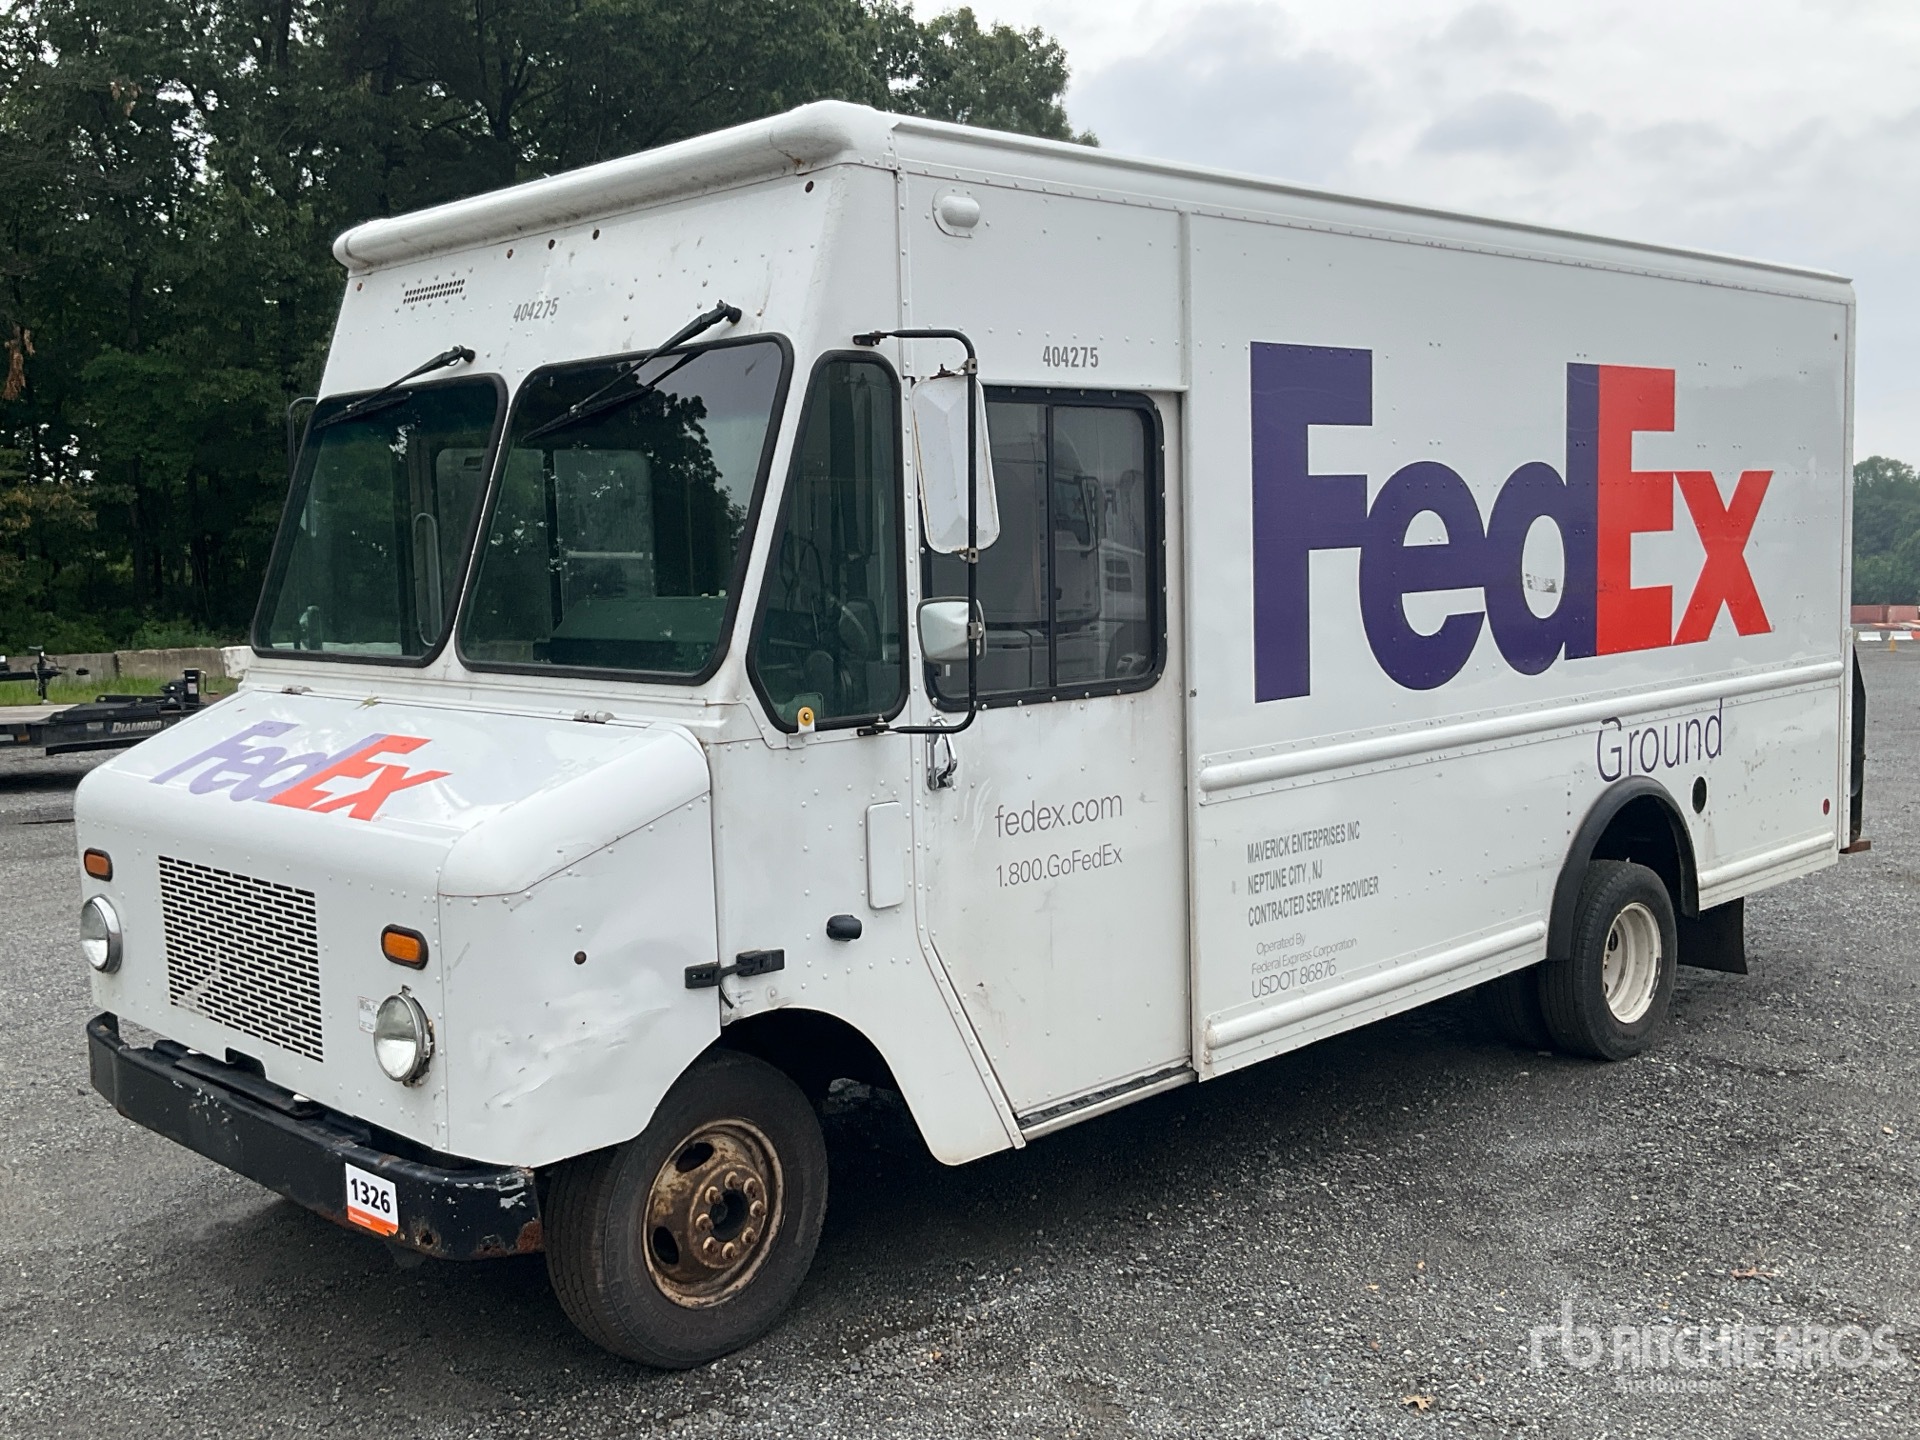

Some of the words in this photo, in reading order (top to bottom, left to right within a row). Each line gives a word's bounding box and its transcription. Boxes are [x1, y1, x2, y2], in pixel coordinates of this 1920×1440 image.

[513, 297, 560, 323] 404275
[1042, 345, 1099, 368] 404275
[1250, 341, 1774, 704] FedEx
[1596, 697, 1723, 783] Ground
[149, 720, 453, 822] FedEx
[994, 794, 1123, 838] fedex.com
[1247, 836, 1291, 864] MAVERICK
[1291, 823, 1346, 854] ENTERPRISES
[1347, 820, 1360, 841] INC
[996, 843, 1123, 888] 1.800.GoFedEx
[1247, 867, 1287, 896] NEPTUNE
[1288, 863, 1307, 886] CITY
[1312, 859, 1323, 880] NJ
[1248, 894, 1305, 927] CONTRACTED
[1306, 885, 1340, 912] SERVICE
[1341, 875, 1379, 903] PROVIDER
[1251, 955, 1281, 975] Federal
[1282, 949, 1313, 967] Express
[1313, 937, 1358, 958] Corporation
[1256, 934, 1295, 956] Operated
[1295, 932, 1306, 947] By
[1251, 968, 1298, 998] USDOT
[1299, 957, 1337, 985] 86876
[350, 1177, 391, 1214] 1326
